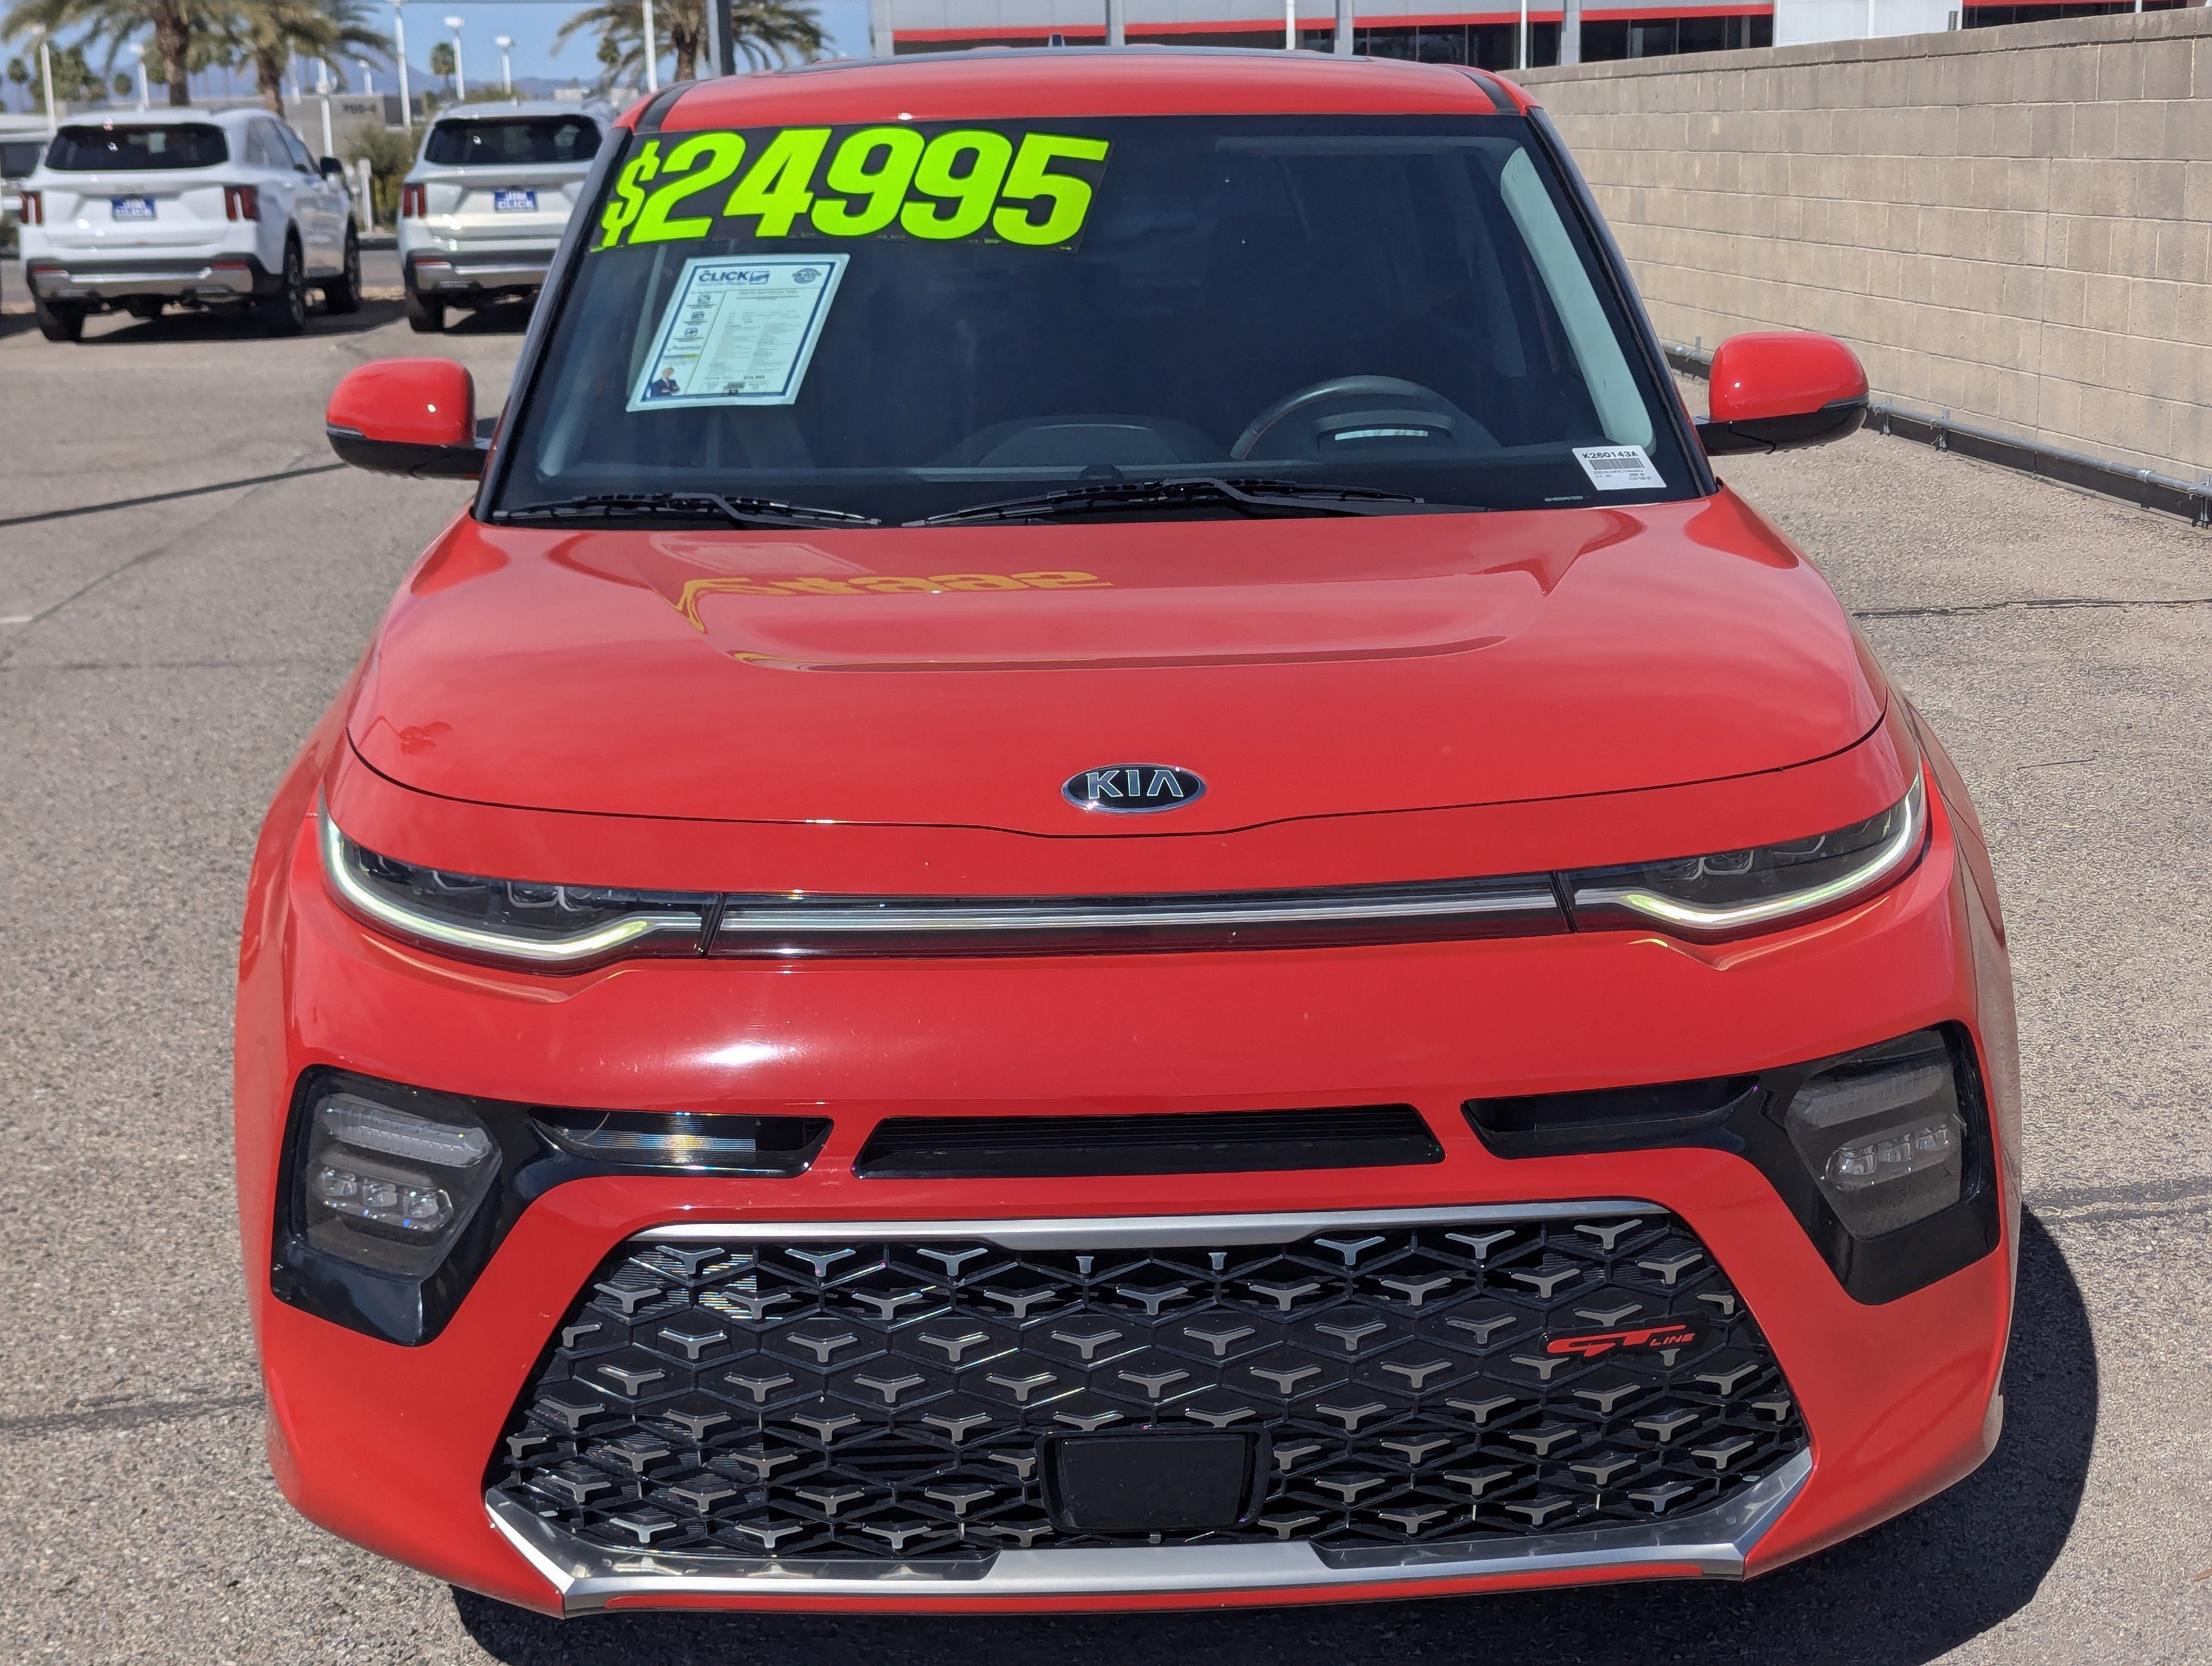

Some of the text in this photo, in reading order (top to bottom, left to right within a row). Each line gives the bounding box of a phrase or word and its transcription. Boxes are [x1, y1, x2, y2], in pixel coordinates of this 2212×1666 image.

[601, 125, 1110, 248] $24995
[698, 271, 750, 283] CLICK
[1085, 769, 1185, 800] KIA
[1547, 1324, 1687, 1357] GT
